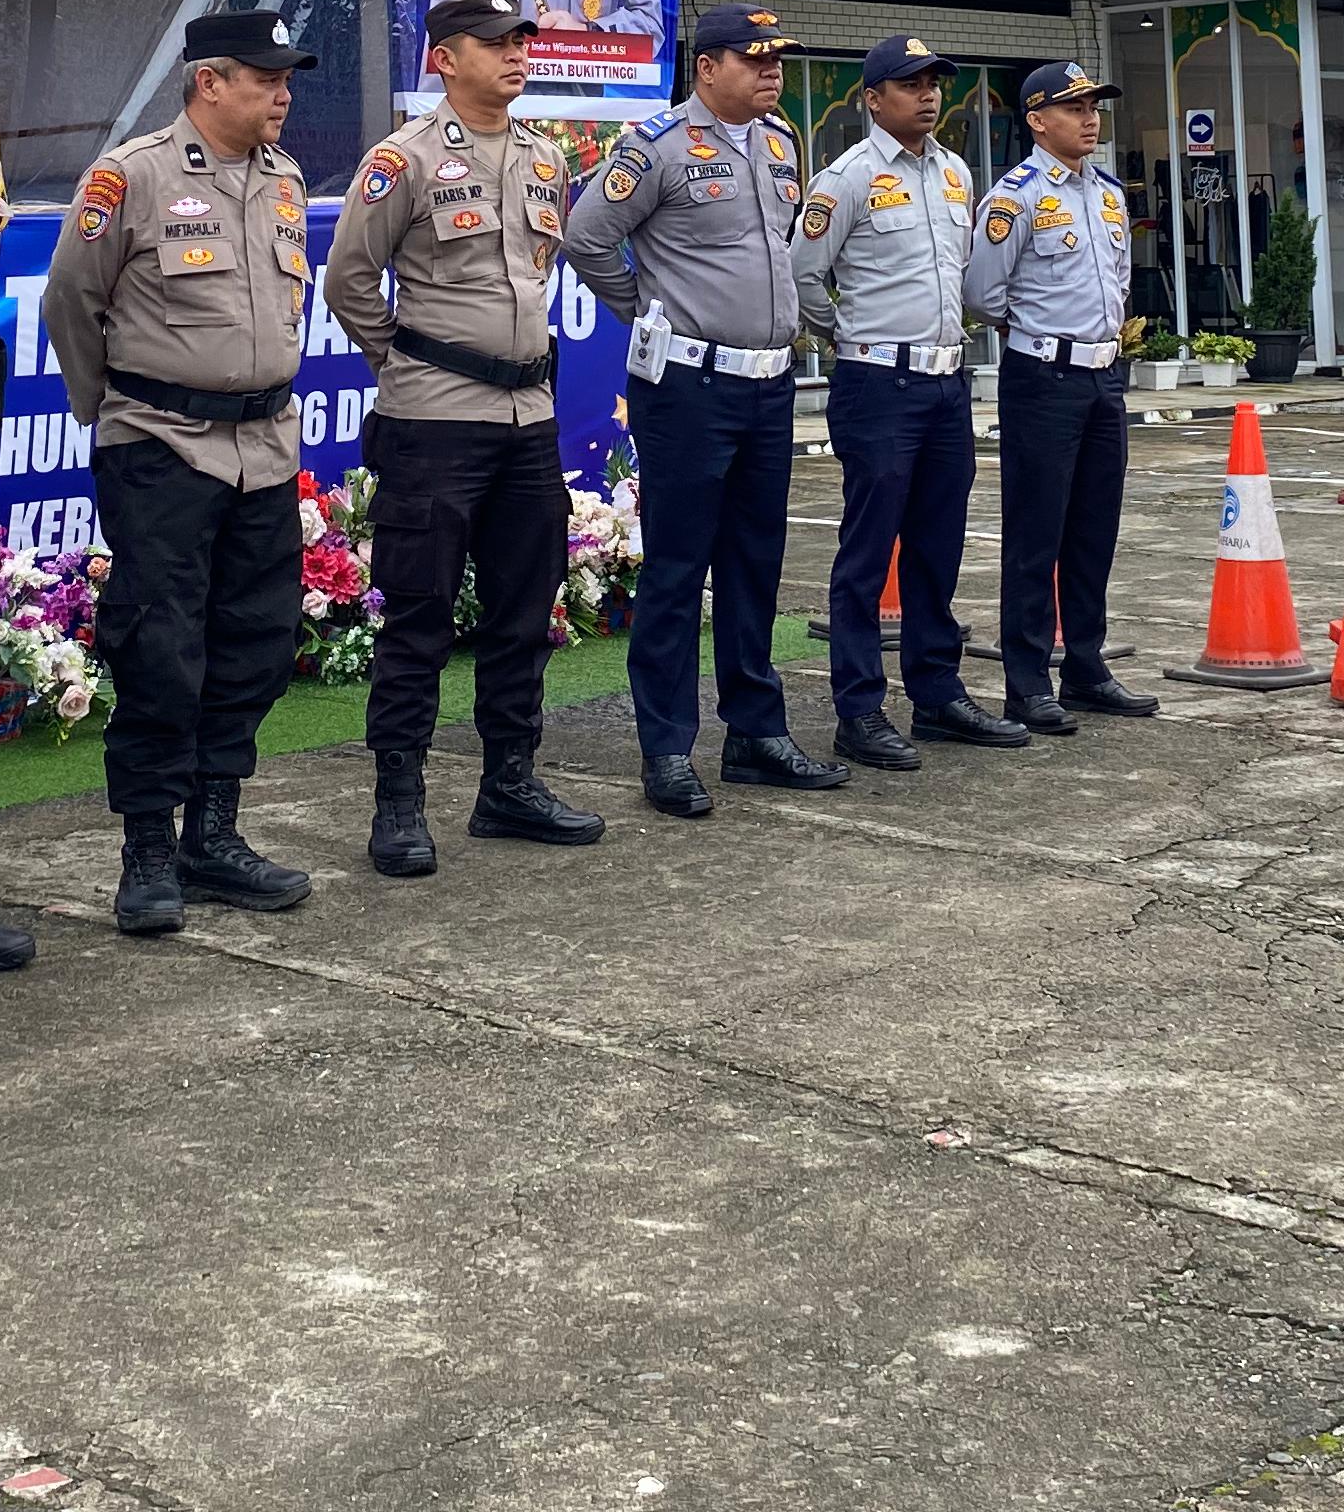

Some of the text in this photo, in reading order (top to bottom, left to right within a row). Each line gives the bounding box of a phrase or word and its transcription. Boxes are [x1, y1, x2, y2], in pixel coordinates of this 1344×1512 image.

[528, 62, 637, 80] RESTA BUKITTINGGI
[432, 187, 467, 205] HARIS
